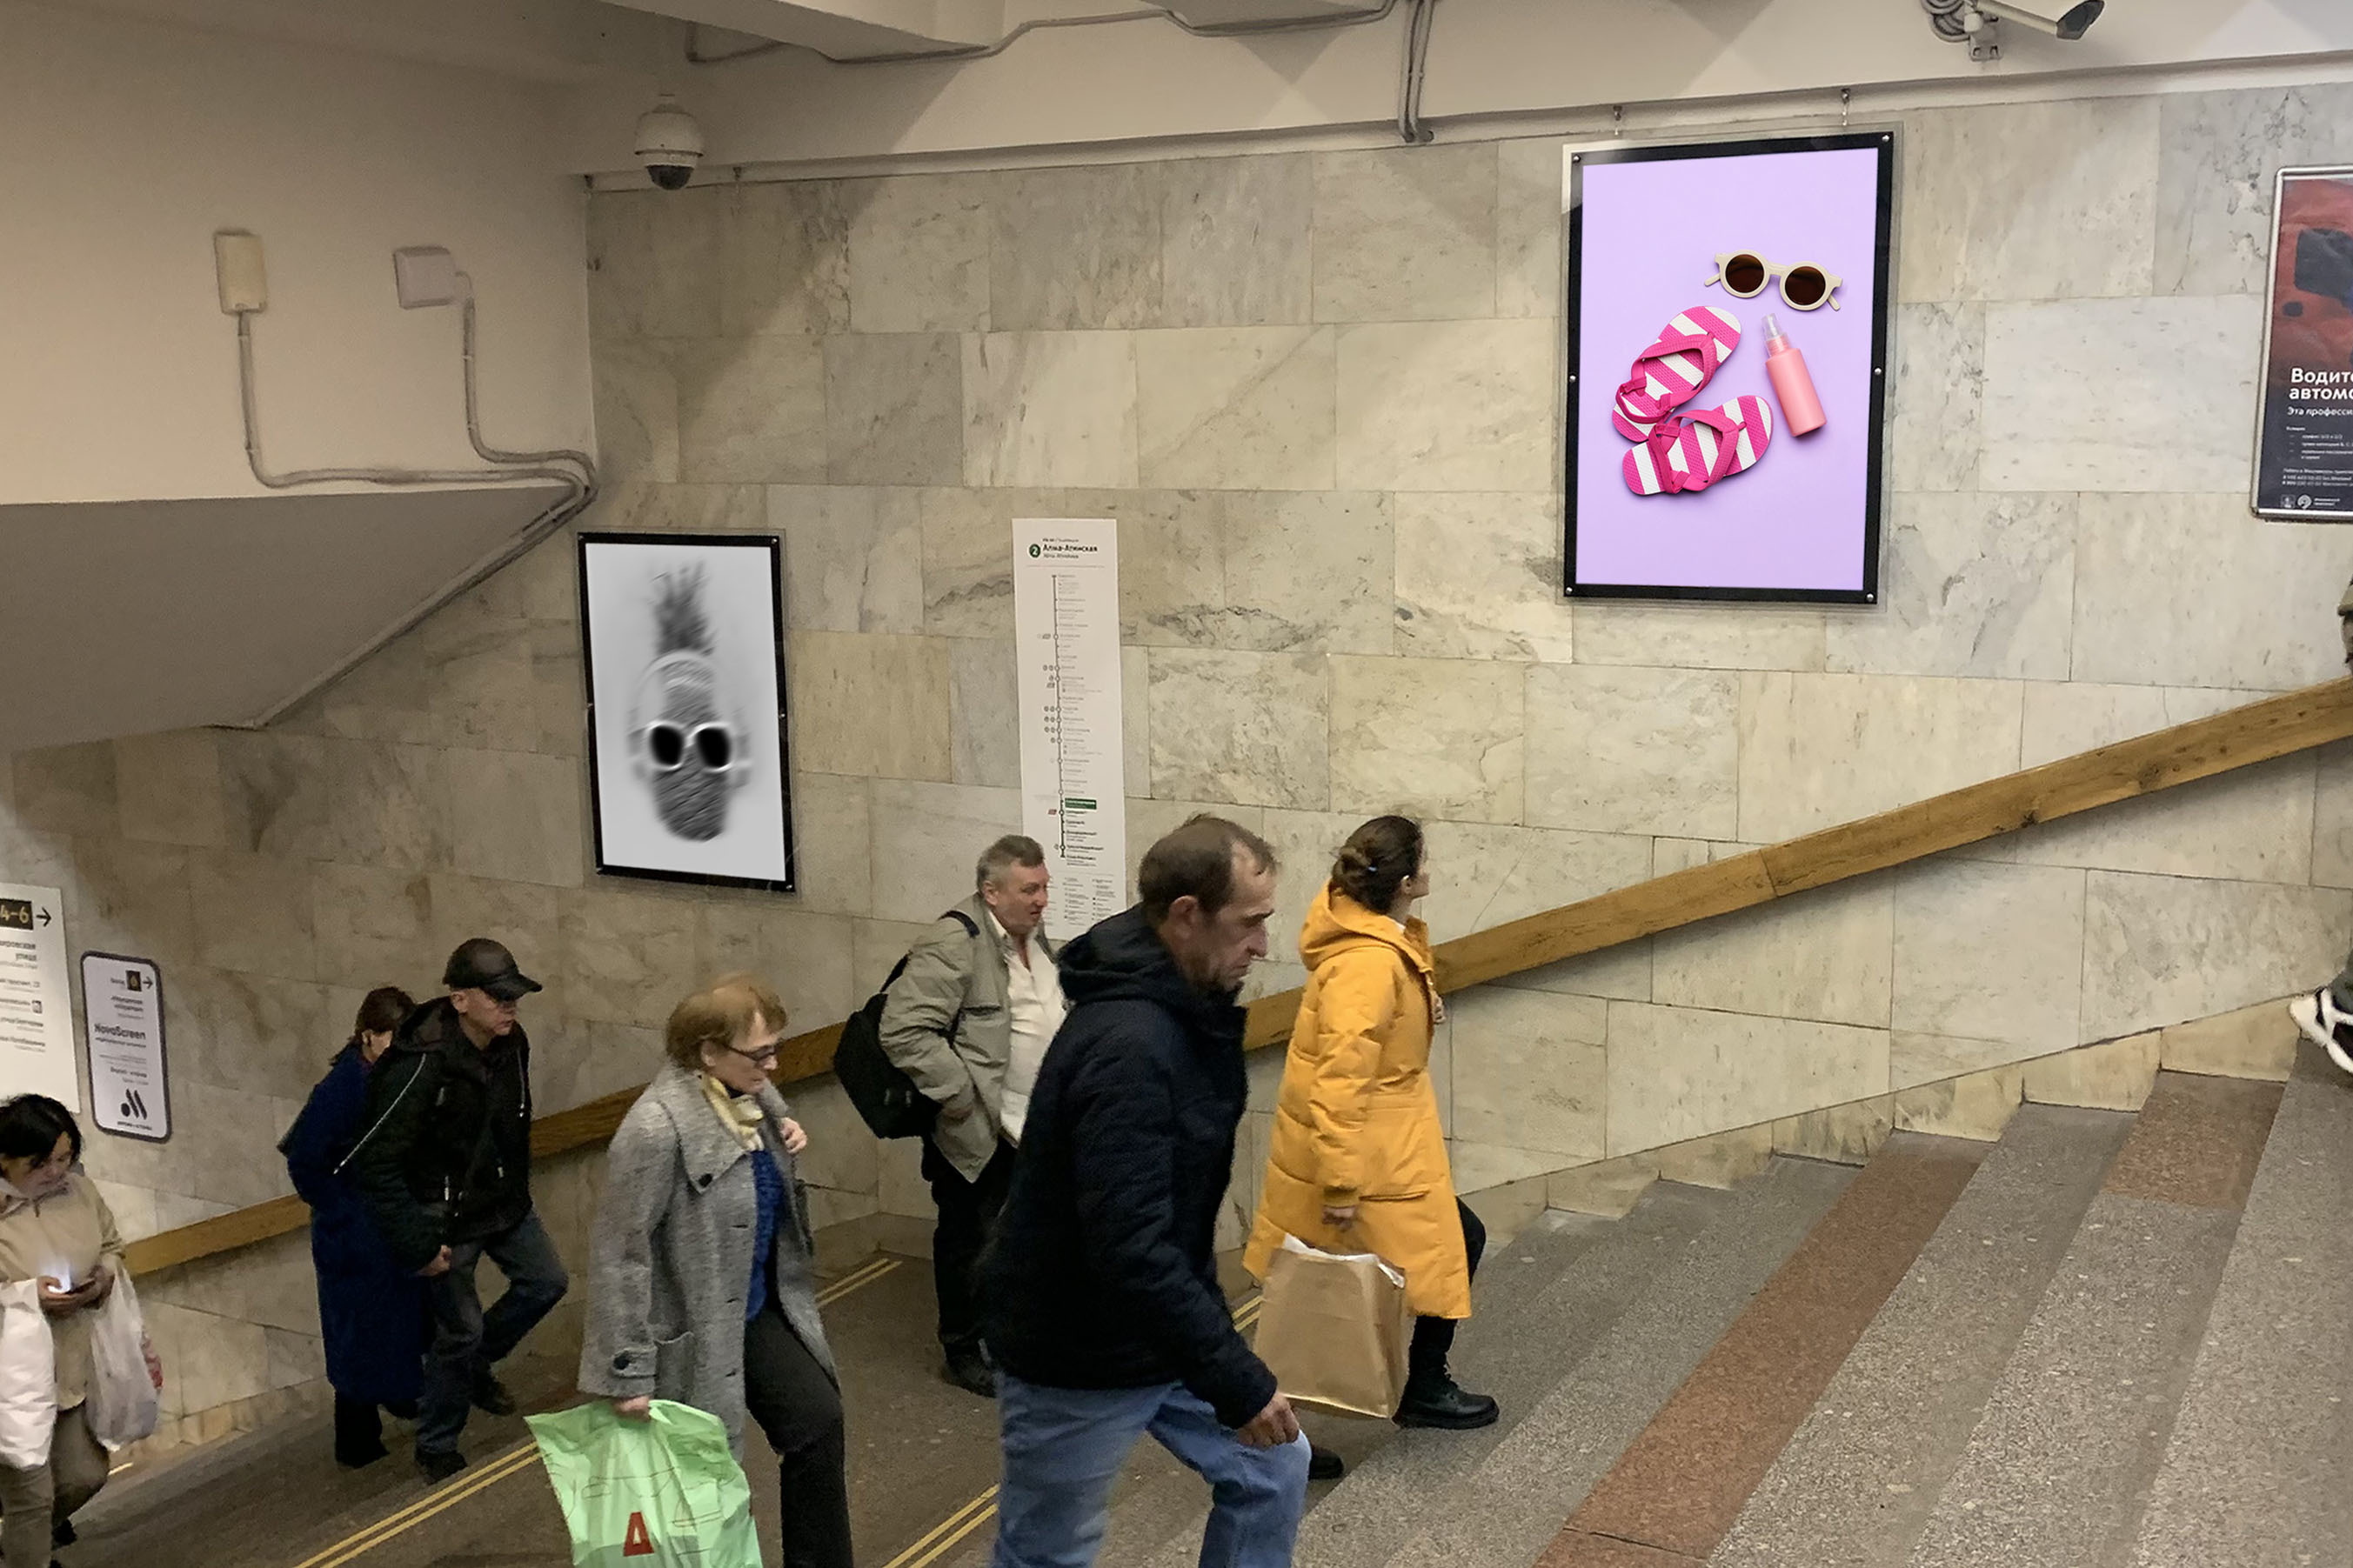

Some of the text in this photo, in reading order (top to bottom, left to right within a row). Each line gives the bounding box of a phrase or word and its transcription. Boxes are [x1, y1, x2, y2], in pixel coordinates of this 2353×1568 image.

[2290, 367, 2353, 385] Водит
[2287, 406, 2305, 416] Эта
[1031, 545, 1039, 556] 2
